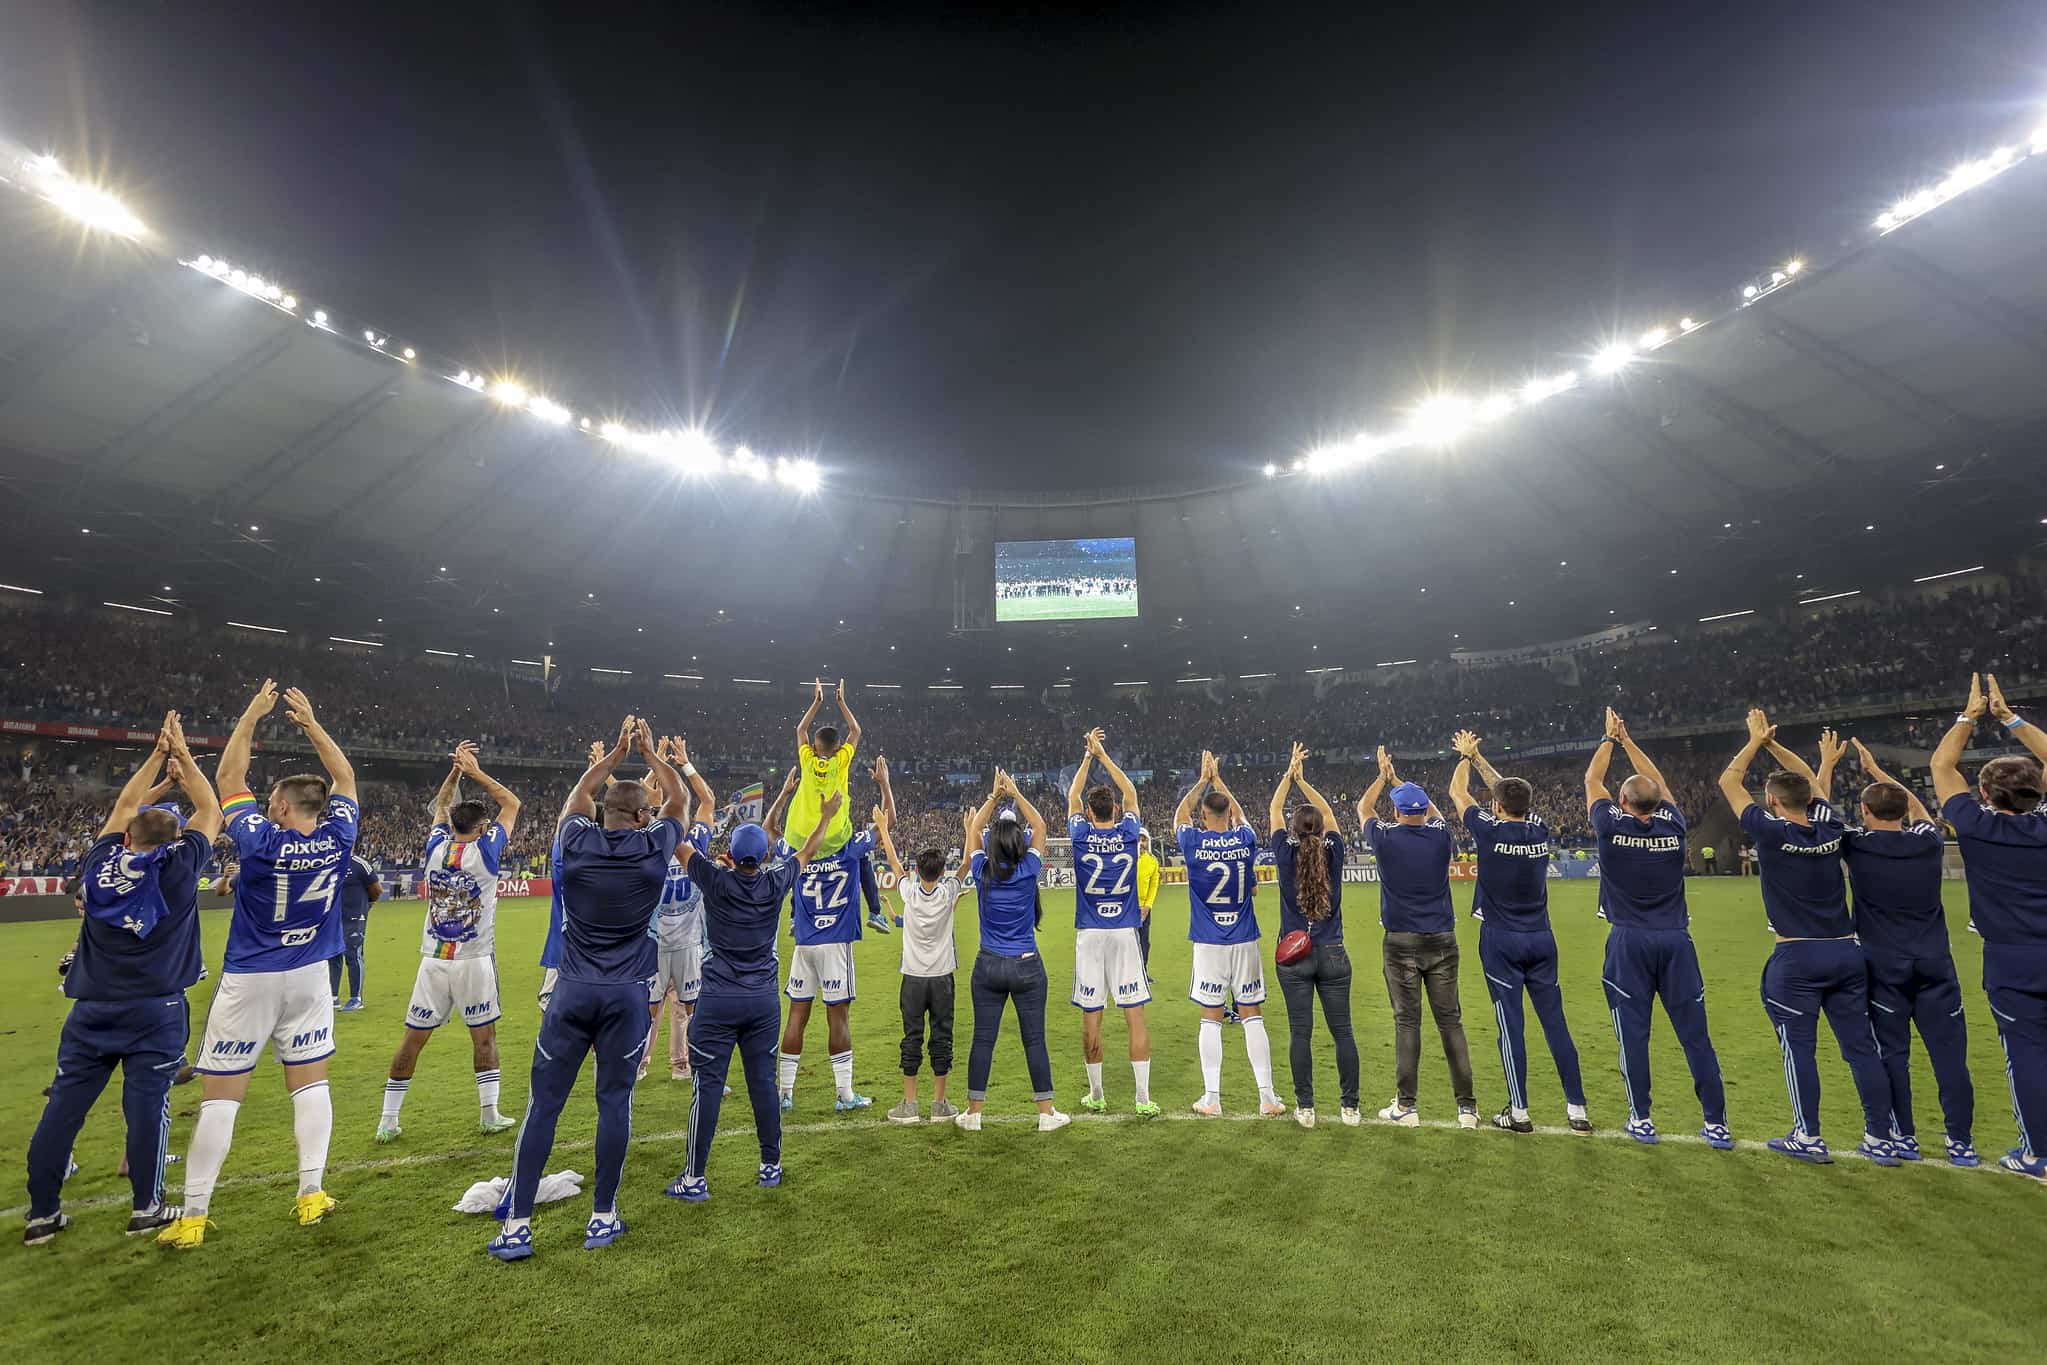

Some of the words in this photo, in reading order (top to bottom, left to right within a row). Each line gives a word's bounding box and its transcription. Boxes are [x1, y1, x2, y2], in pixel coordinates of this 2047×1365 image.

[1195, 848, 1220, 860] PEDRO
[1221, 847, 1250, 860] CASTRO
[1202, 836, 1242, 848] pixbet
[273, 867, 338, 921] 14
[802, 871, 849, 909] 42
[1081, 853, 1134, 895] 22
[1206, 861, 1246, 904] 21
